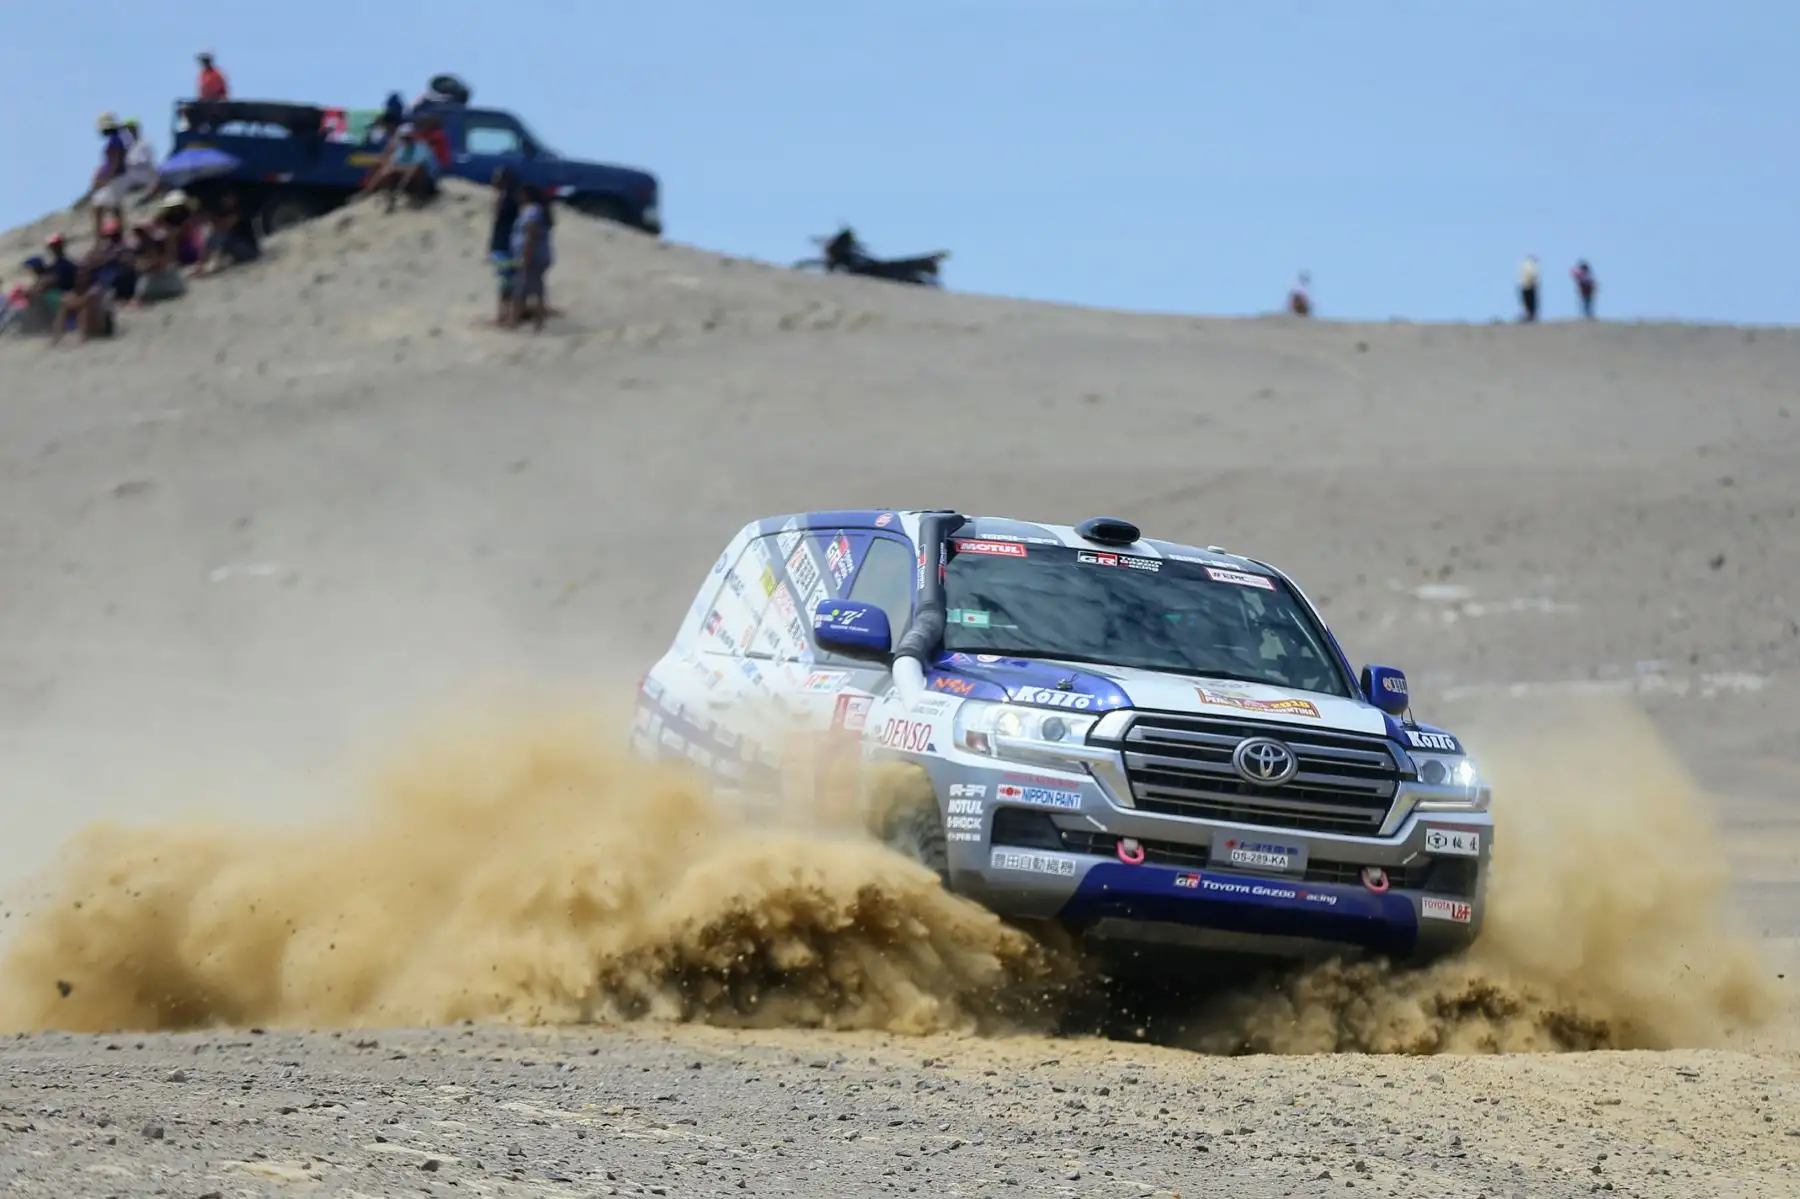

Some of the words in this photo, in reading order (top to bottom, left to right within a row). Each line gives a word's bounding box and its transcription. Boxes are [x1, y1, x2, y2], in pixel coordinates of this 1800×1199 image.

[961, 543, 1021, 555] MOTUL
[1080, 555, 1115, 567] GR
[881, 719, 932, 751] DENSO
[1023, 788, 1054, 804] NIPPON
[1055, 792, 1081, 809] PAINT
[1232, 851, 1287, 866] DS-289-KA
[1202, 880, 1251, 893] TOYOTA
[1423, 900, 1451, 910] TOYOTA
